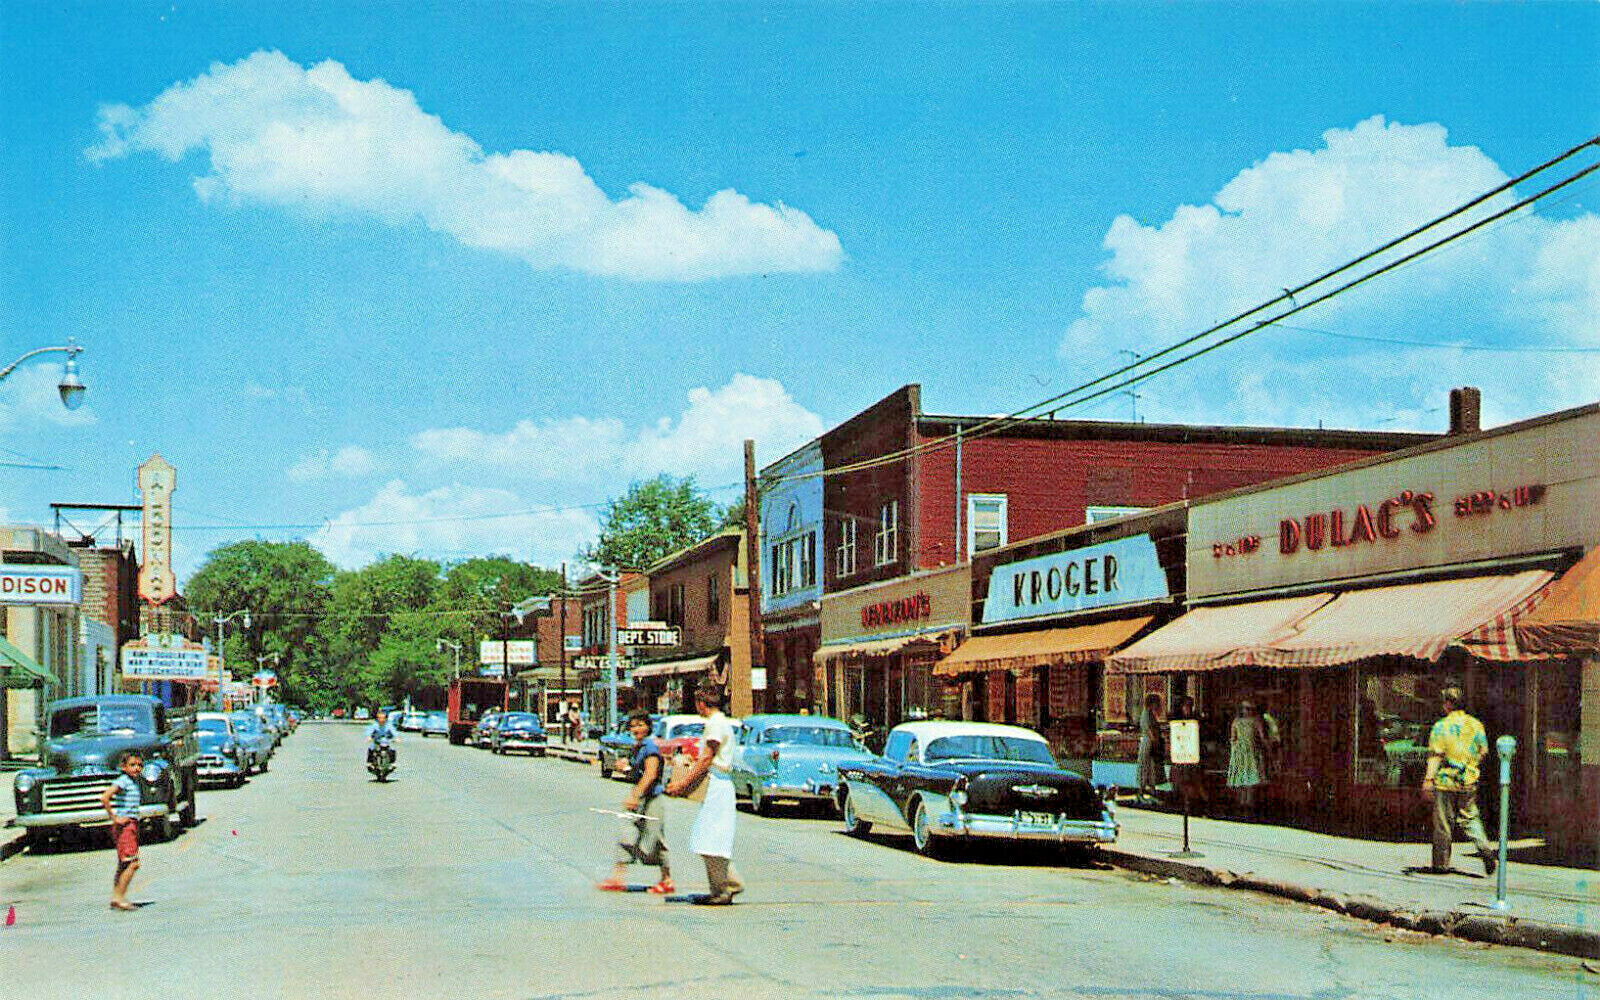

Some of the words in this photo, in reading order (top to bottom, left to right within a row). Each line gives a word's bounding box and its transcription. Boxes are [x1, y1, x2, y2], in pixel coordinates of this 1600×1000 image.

[1279, 490, 1437, 555] DULAC'S
[2, 577, 67, 594] DISON
[1014, 556, 1121, 607] KROGER
[647, 630, 679, 645] STORE
